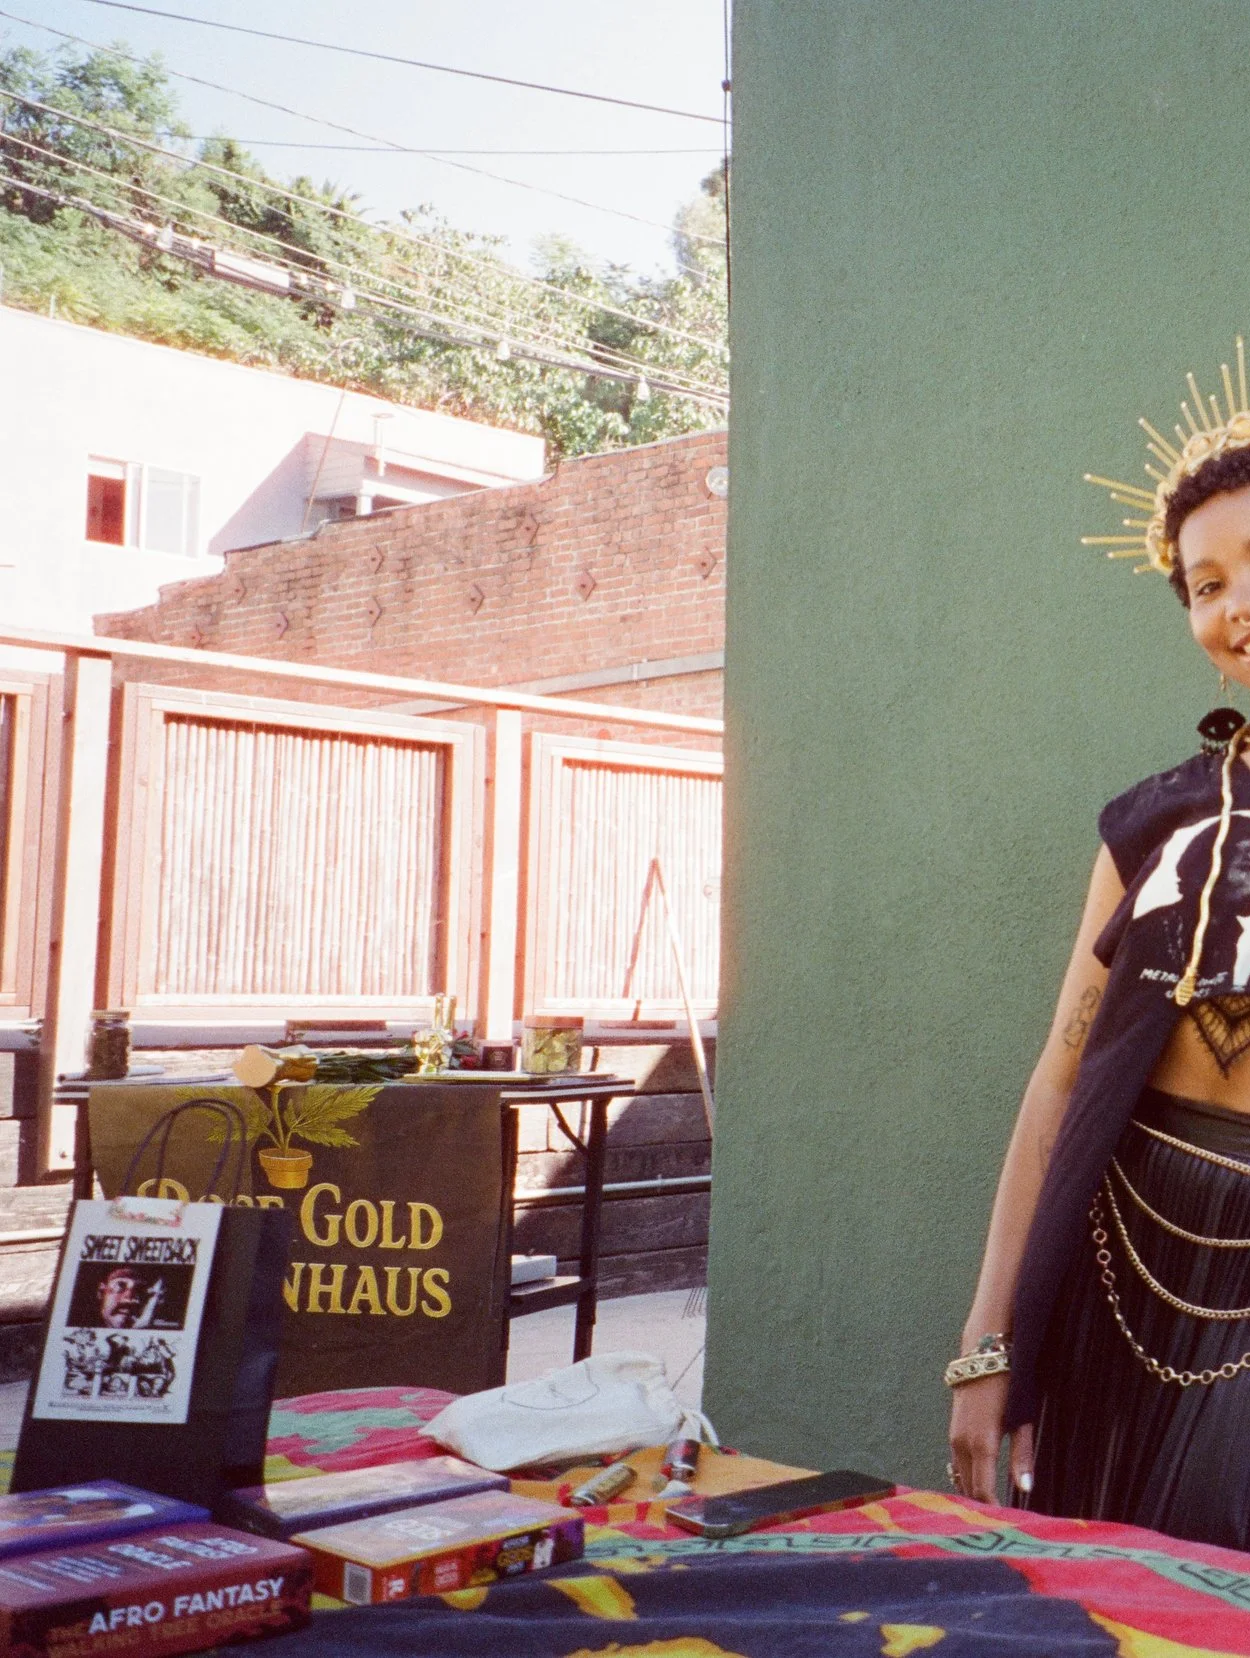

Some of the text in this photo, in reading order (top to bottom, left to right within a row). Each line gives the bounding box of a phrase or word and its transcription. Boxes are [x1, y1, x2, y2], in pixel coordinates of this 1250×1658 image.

[300, 1182, 445, 1250] GOLD
[80, 1234, 125, 1261] SWEET
[88, 1576, 286, 1635] AFRO FANTASY
